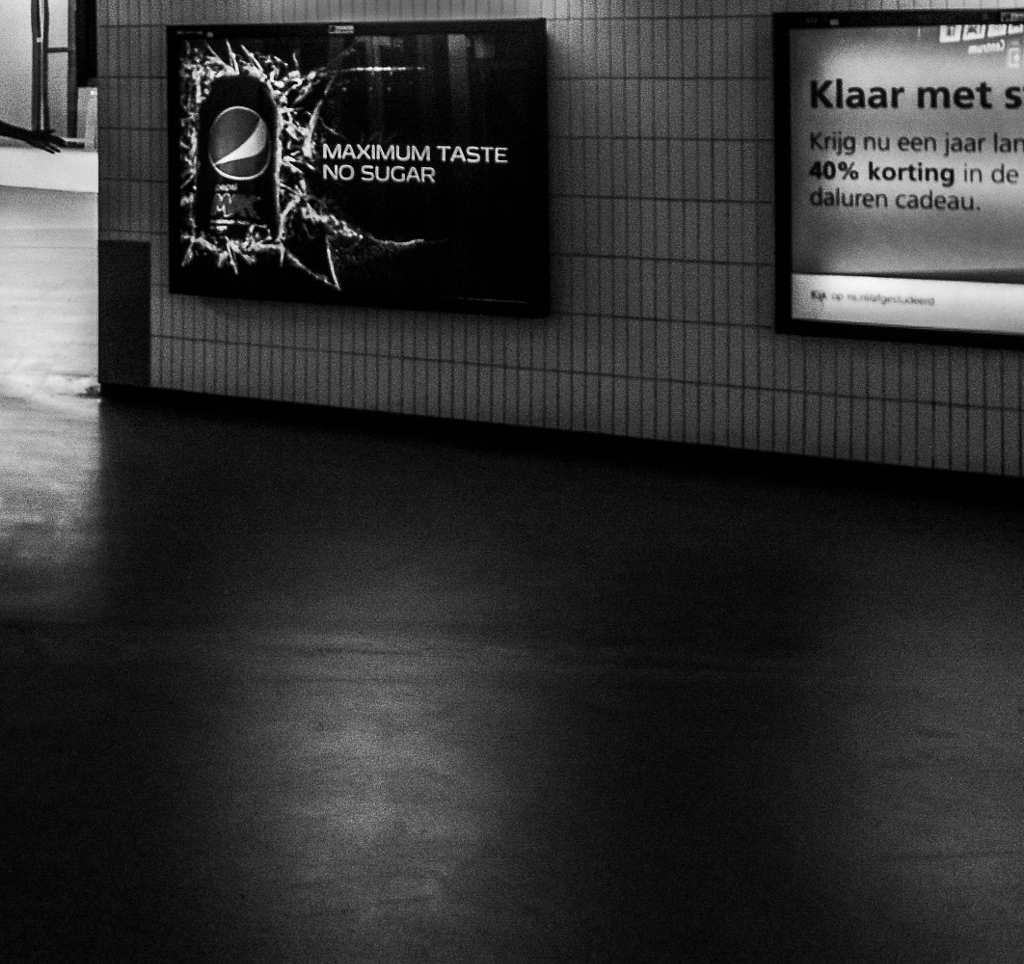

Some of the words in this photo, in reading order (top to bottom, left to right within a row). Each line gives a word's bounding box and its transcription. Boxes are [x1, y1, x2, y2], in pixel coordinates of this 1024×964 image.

[809, 78, 905, 109] Klaar
[918, 82, 993, 109] met
[1005, 86, 1024, 109] s
[323, 143, 431, 162] MAXIMUM
[437, 146, 509, 164] TASTE
[809, 131, 856, 156] Krijg
[863, 135, 890, 152] nu
[897, 135, 937, 152] een
[943, 132, 986, 157] jaar
[323, 164, 355, 181] NO
[360, 166, 436, 184] SUGAR
[809, 161, 859, 180] 40%
[868, 161, 955, 187] korting
[963, 162, 983, 183] in
[991, 162, 1019, 183] de
[809, 187, 888, 208] daluren
[895, 189, 981, 211] cadeau.
